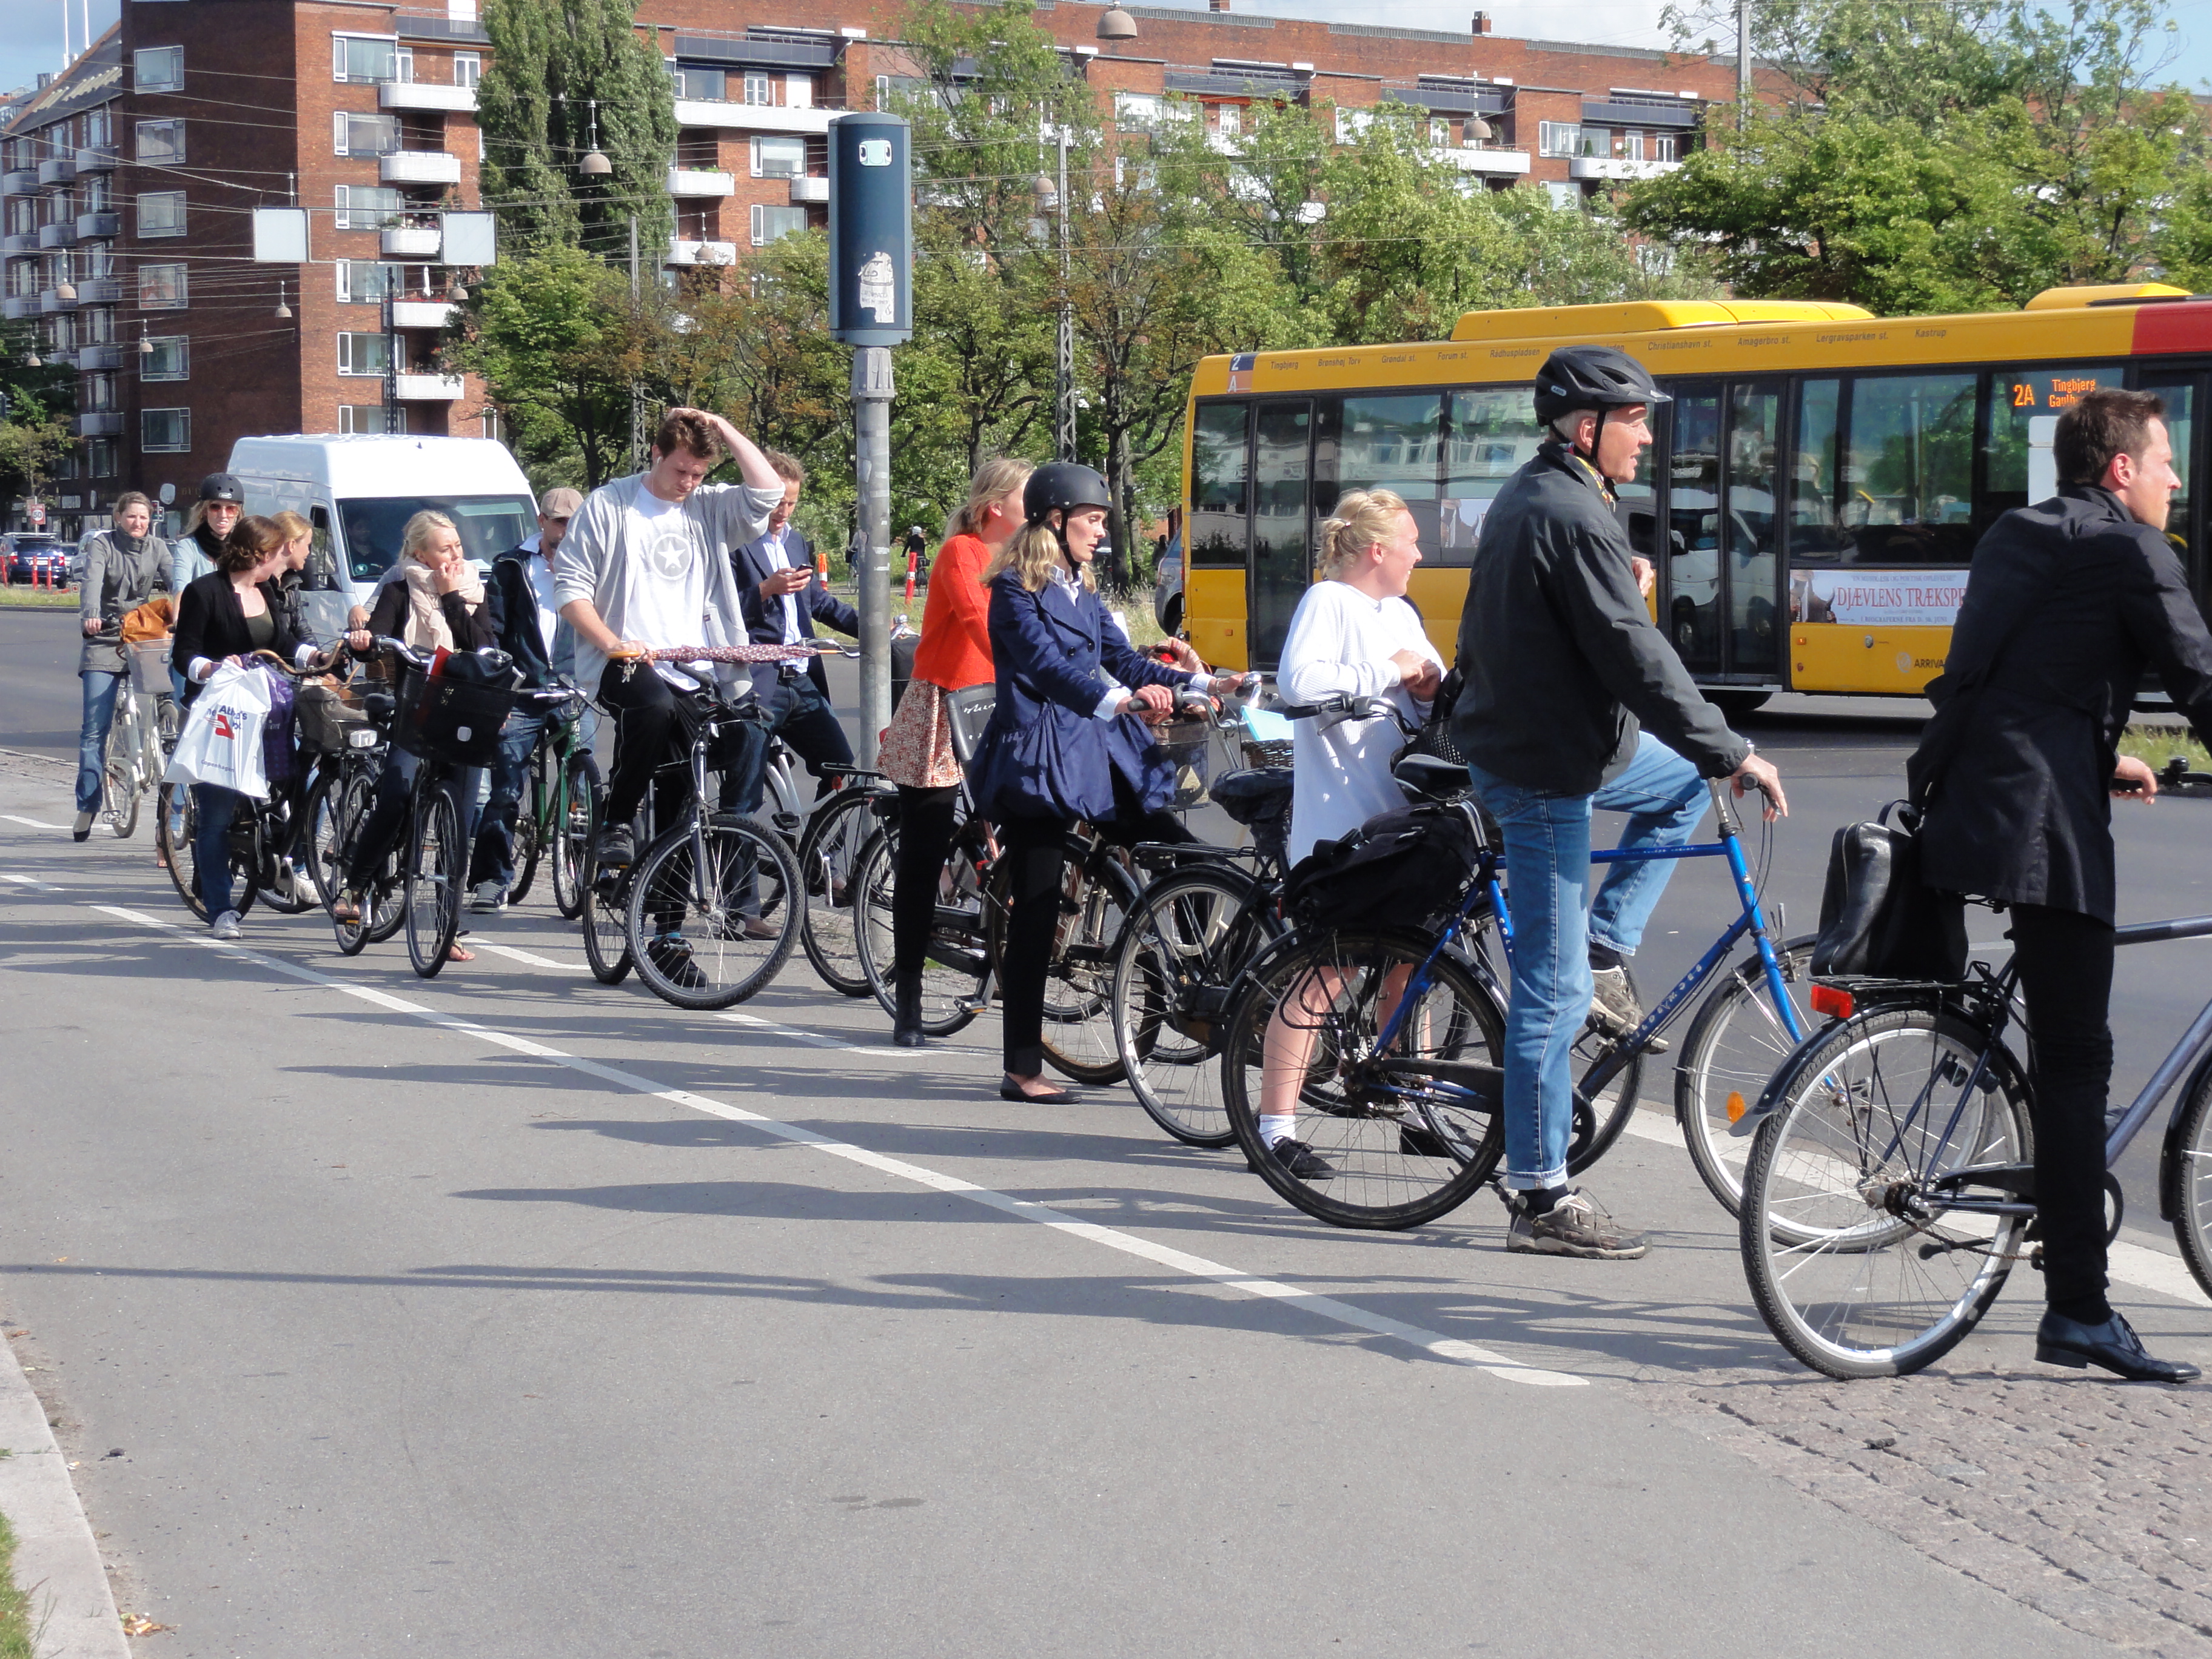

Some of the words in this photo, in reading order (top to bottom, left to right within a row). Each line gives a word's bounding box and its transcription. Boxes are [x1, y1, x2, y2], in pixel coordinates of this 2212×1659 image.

[1878, 331, 1889, 340] st.
[1915, 329, 1946, 339] Kastrup
[1647, 340, 1701, 350] Christianshavn
[1703, 340, 1712, 348] st.
[1737, 337, 1778, 347] Amagerbro
[1781, 335, 1791, 344] st.
[1438, 352, 1458, 360] Forum
[1231, 355, 1241, 370] 2
[1270, 361, 1299, 370] Tingbjerg
[1227, 375, 1236, 393] A
[2051, 378, 2096, 394] Tingbjerg
[2013, 384, 2034, 406] 2A
[1837, 587, 1902, 611] DJÆVLENS
[1914, 659, 1944, 668] ARRIVA
[201, 759, 235, 773] Copenhagen
